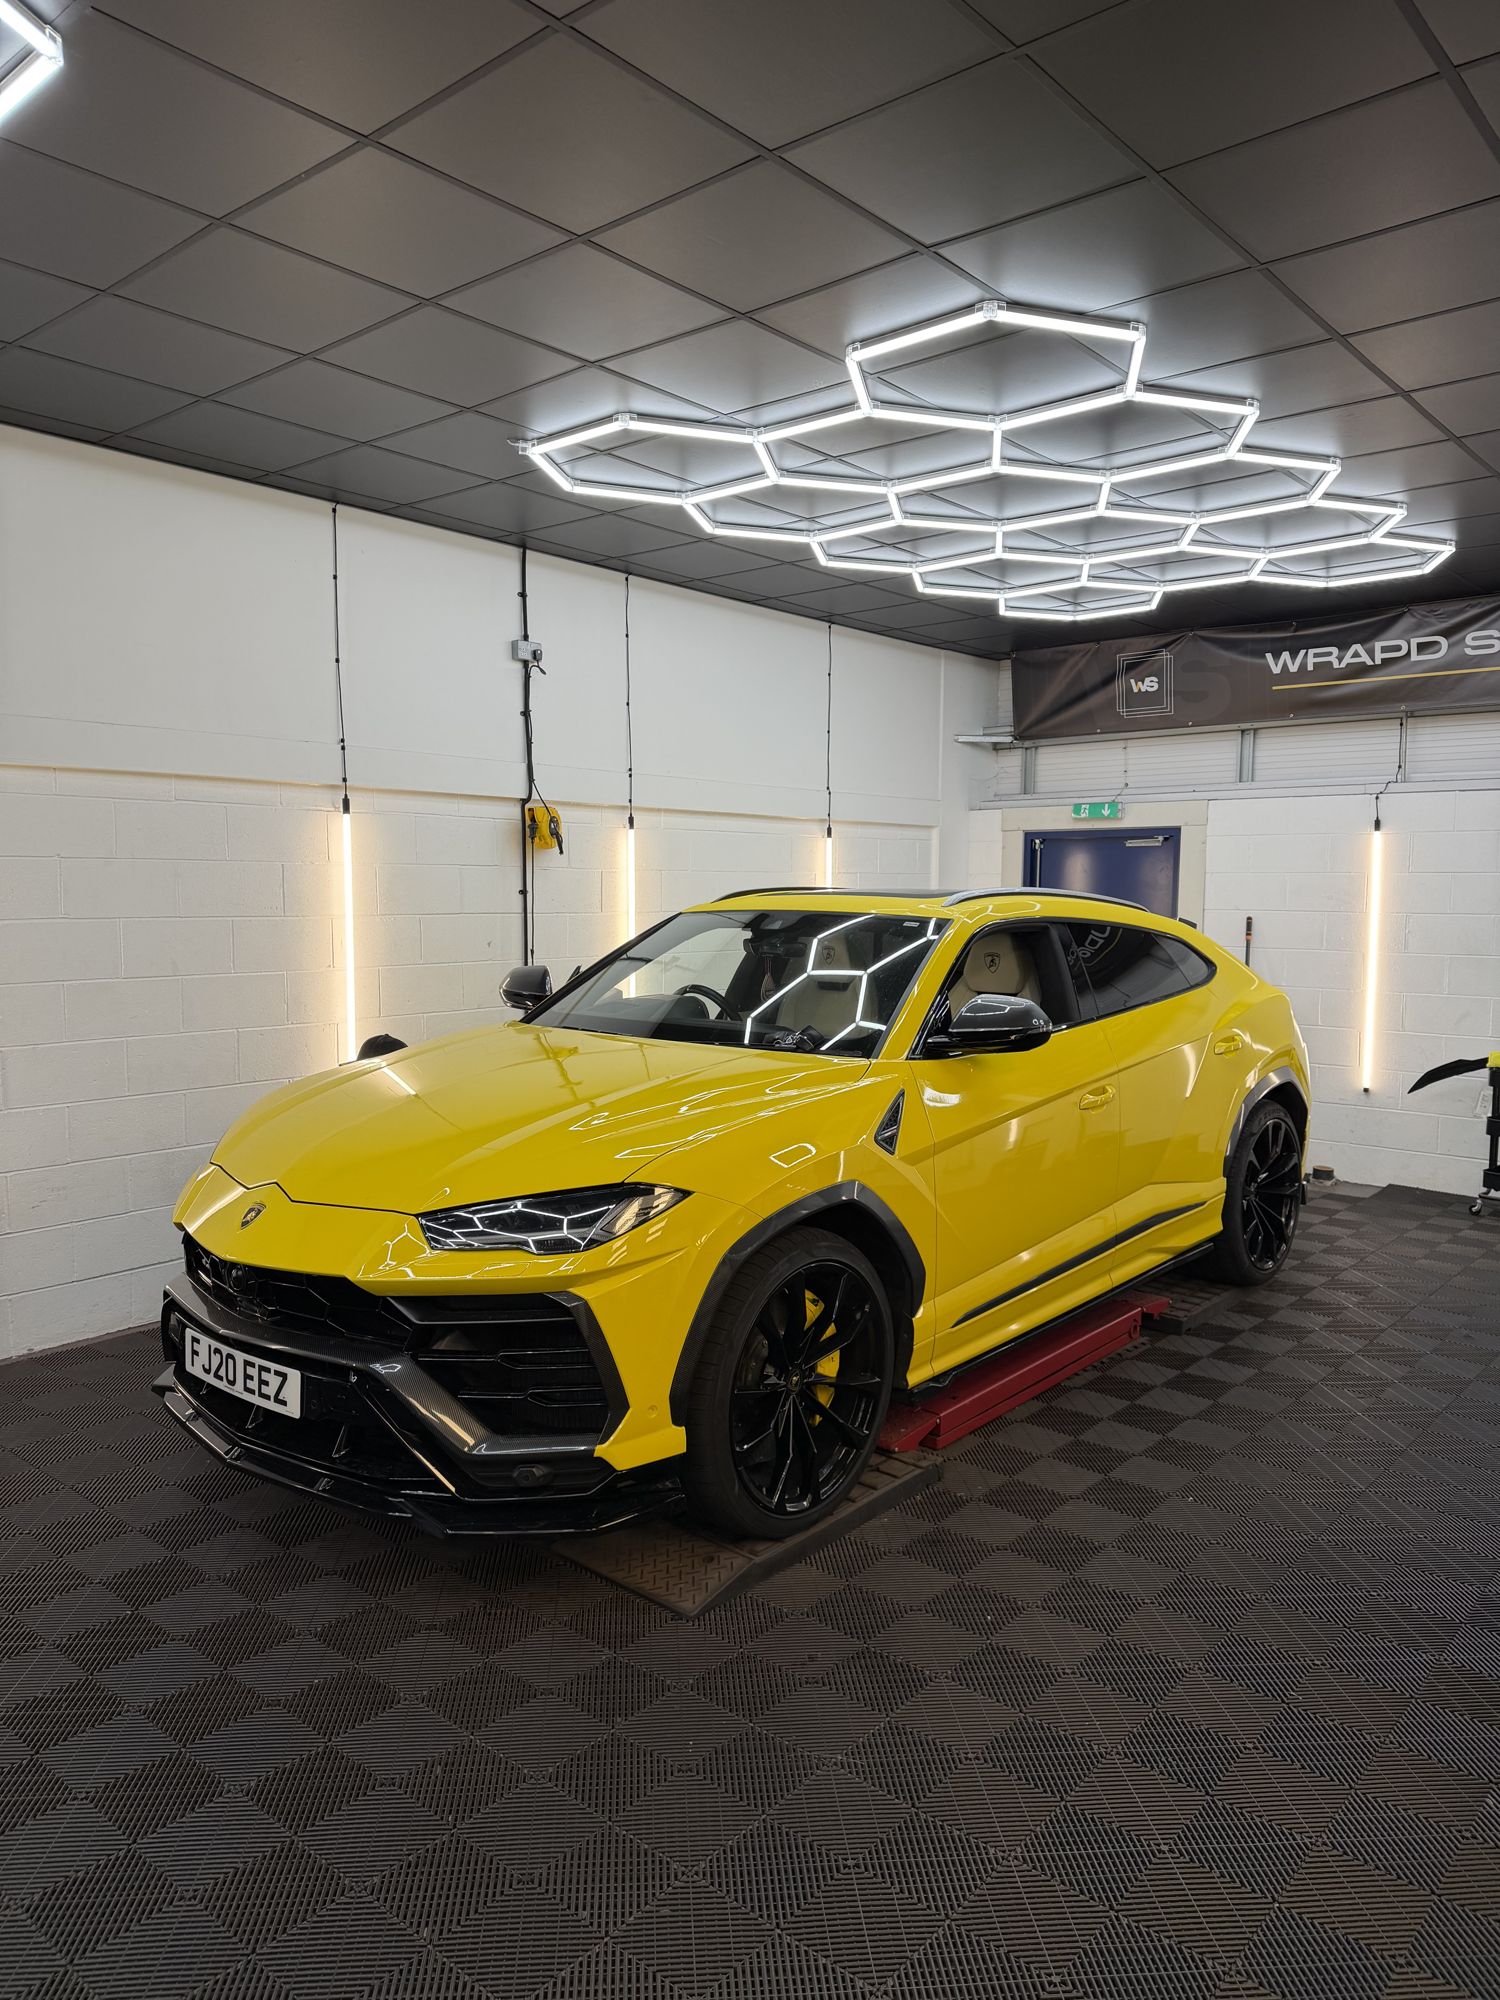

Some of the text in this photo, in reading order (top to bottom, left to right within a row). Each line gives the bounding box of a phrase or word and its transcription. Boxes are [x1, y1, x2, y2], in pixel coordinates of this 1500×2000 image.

[1265, 635, 1449, 674] WRAPD
[1130, 676, 1159, 693] WS
[191, 1335, 288, 1407] FJ20 EEZ
